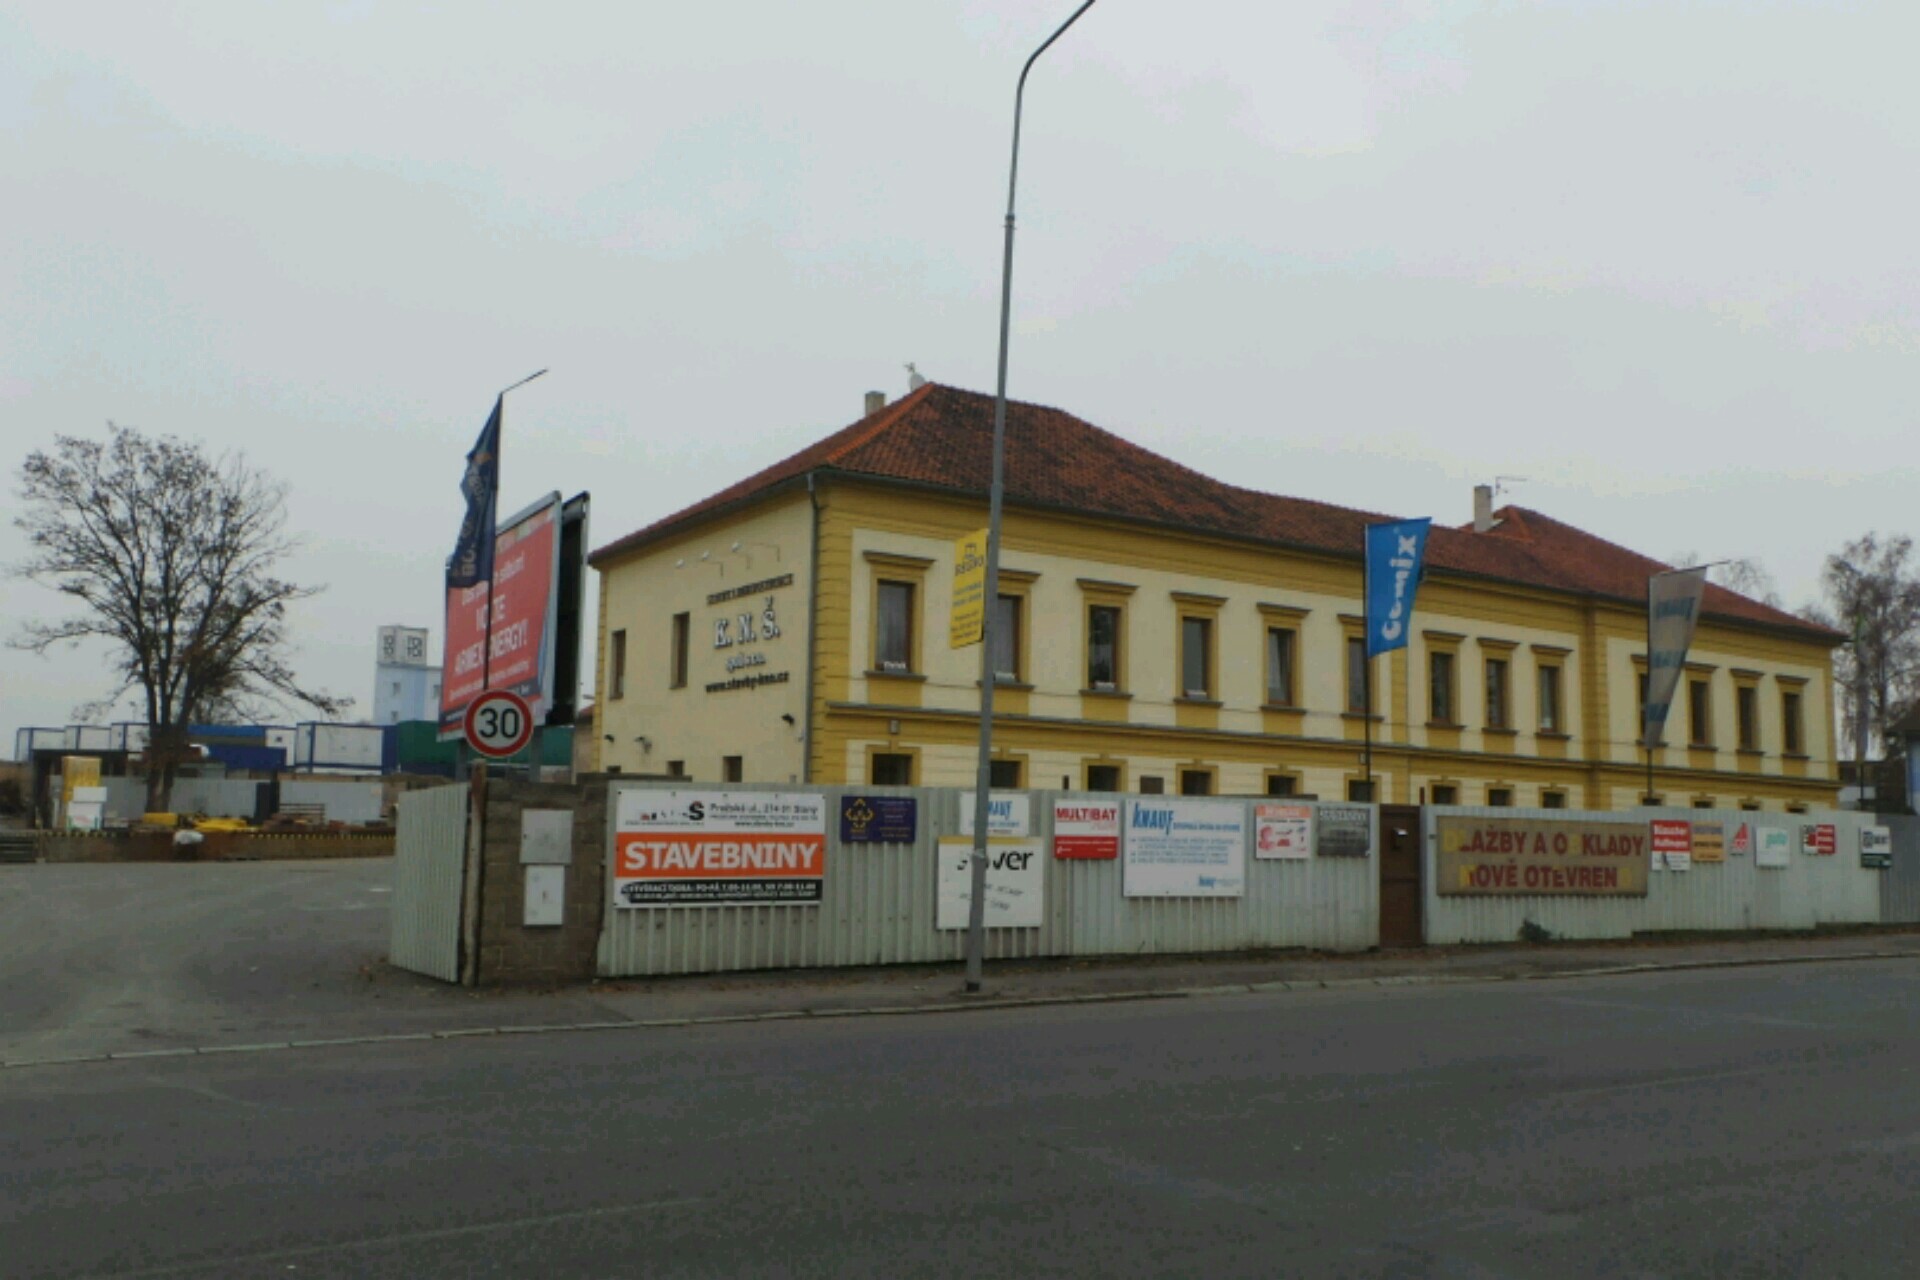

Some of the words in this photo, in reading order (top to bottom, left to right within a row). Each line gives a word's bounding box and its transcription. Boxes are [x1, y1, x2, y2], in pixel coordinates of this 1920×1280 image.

[761, 595, 781, 641] Š.
[490, 618, 529, 661] NERGY!
[479, 708, 518, 738] 30
[1056, 807, 1118, 821] MULTIBAT
[624, 841, 818, 870] STAVEBNINY
[1533, 831, 1547, 854] A
